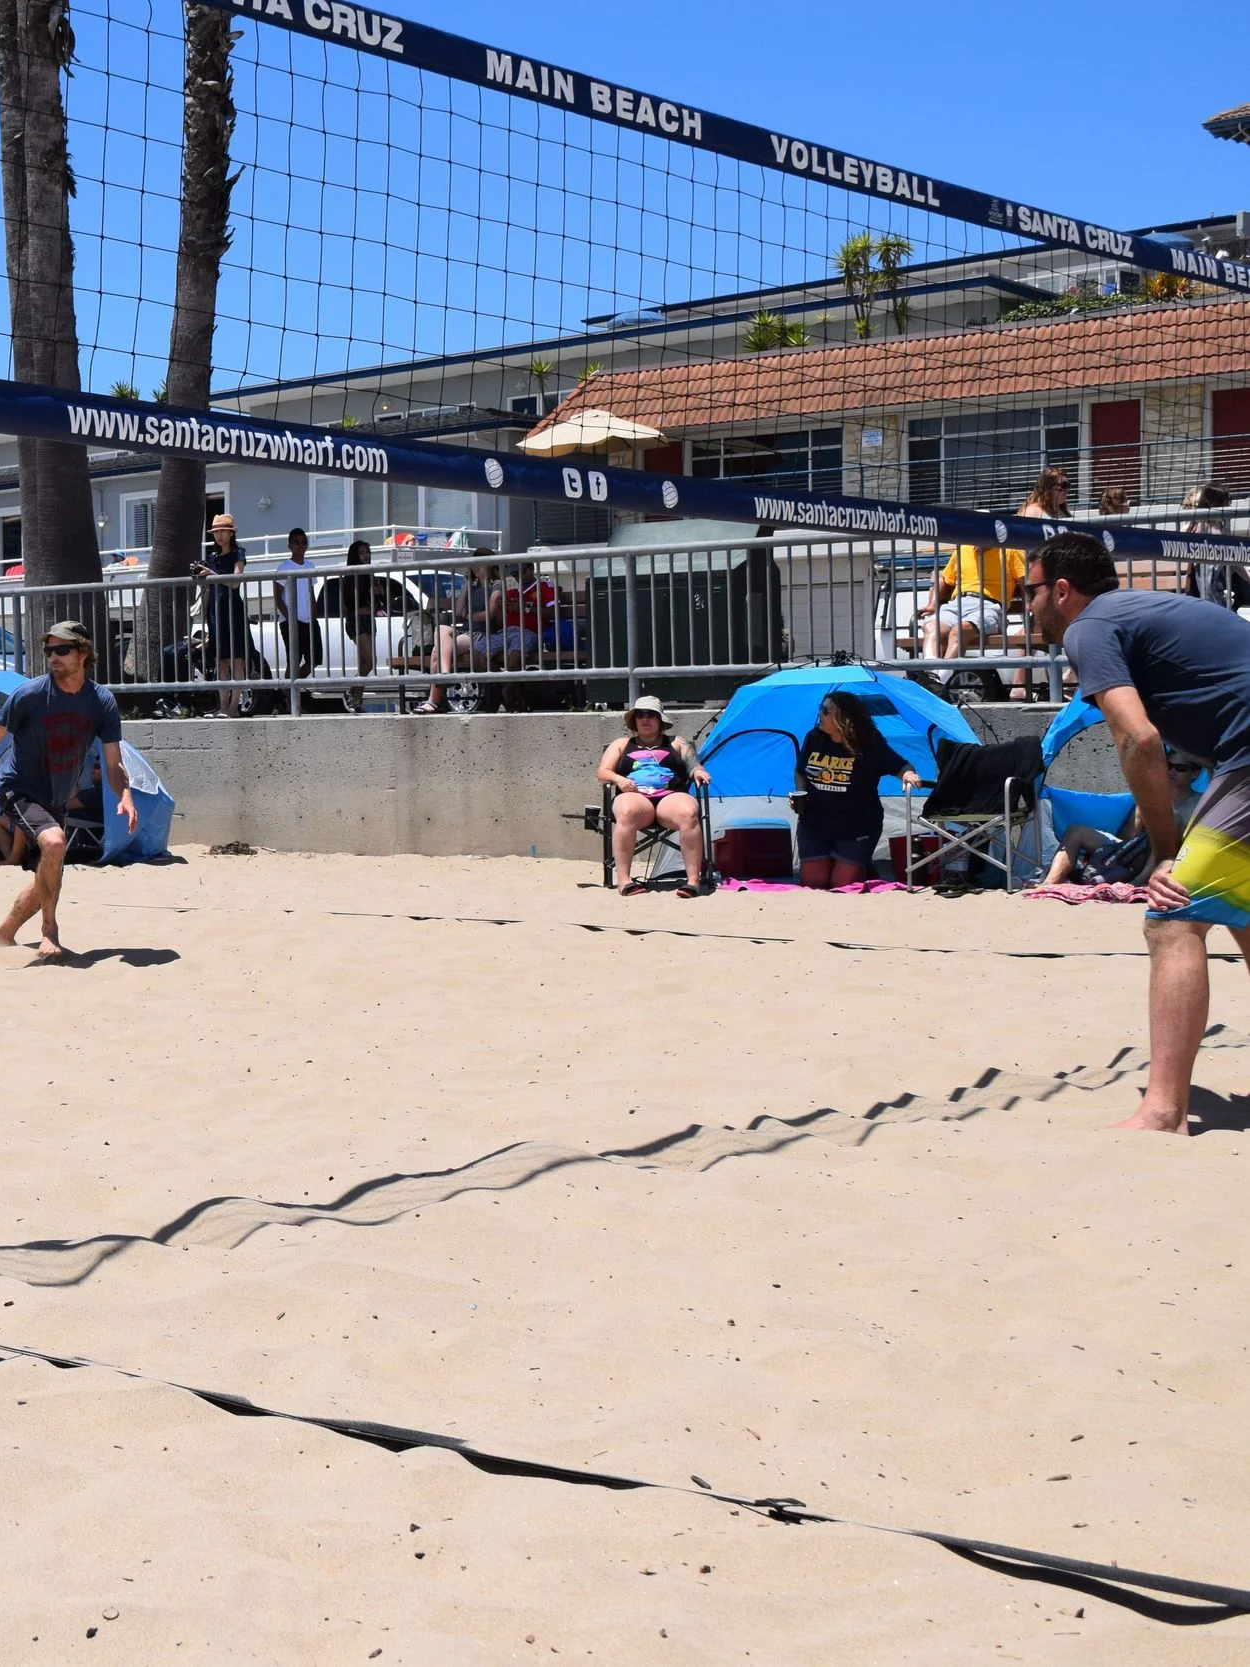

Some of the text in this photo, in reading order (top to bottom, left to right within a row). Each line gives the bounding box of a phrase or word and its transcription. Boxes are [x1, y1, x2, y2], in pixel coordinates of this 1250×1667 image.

[303, 0, 404, 53] CRUZ
[485, 49, 575, 104] MAIN
[589, 81, 703, 141] BEACH
[770, 134, 940, 207] VOLLEYBALL
[1018, 206, 1081, 245] SANTA
[1085, 224, 1134, 259] CRUZ
[1170, 248, 1218, 279] MAIN
[67, 405, 388, 474] www.santacruzwharf.com
[754, 496, 938, 537] www.santacruzwharf.com
